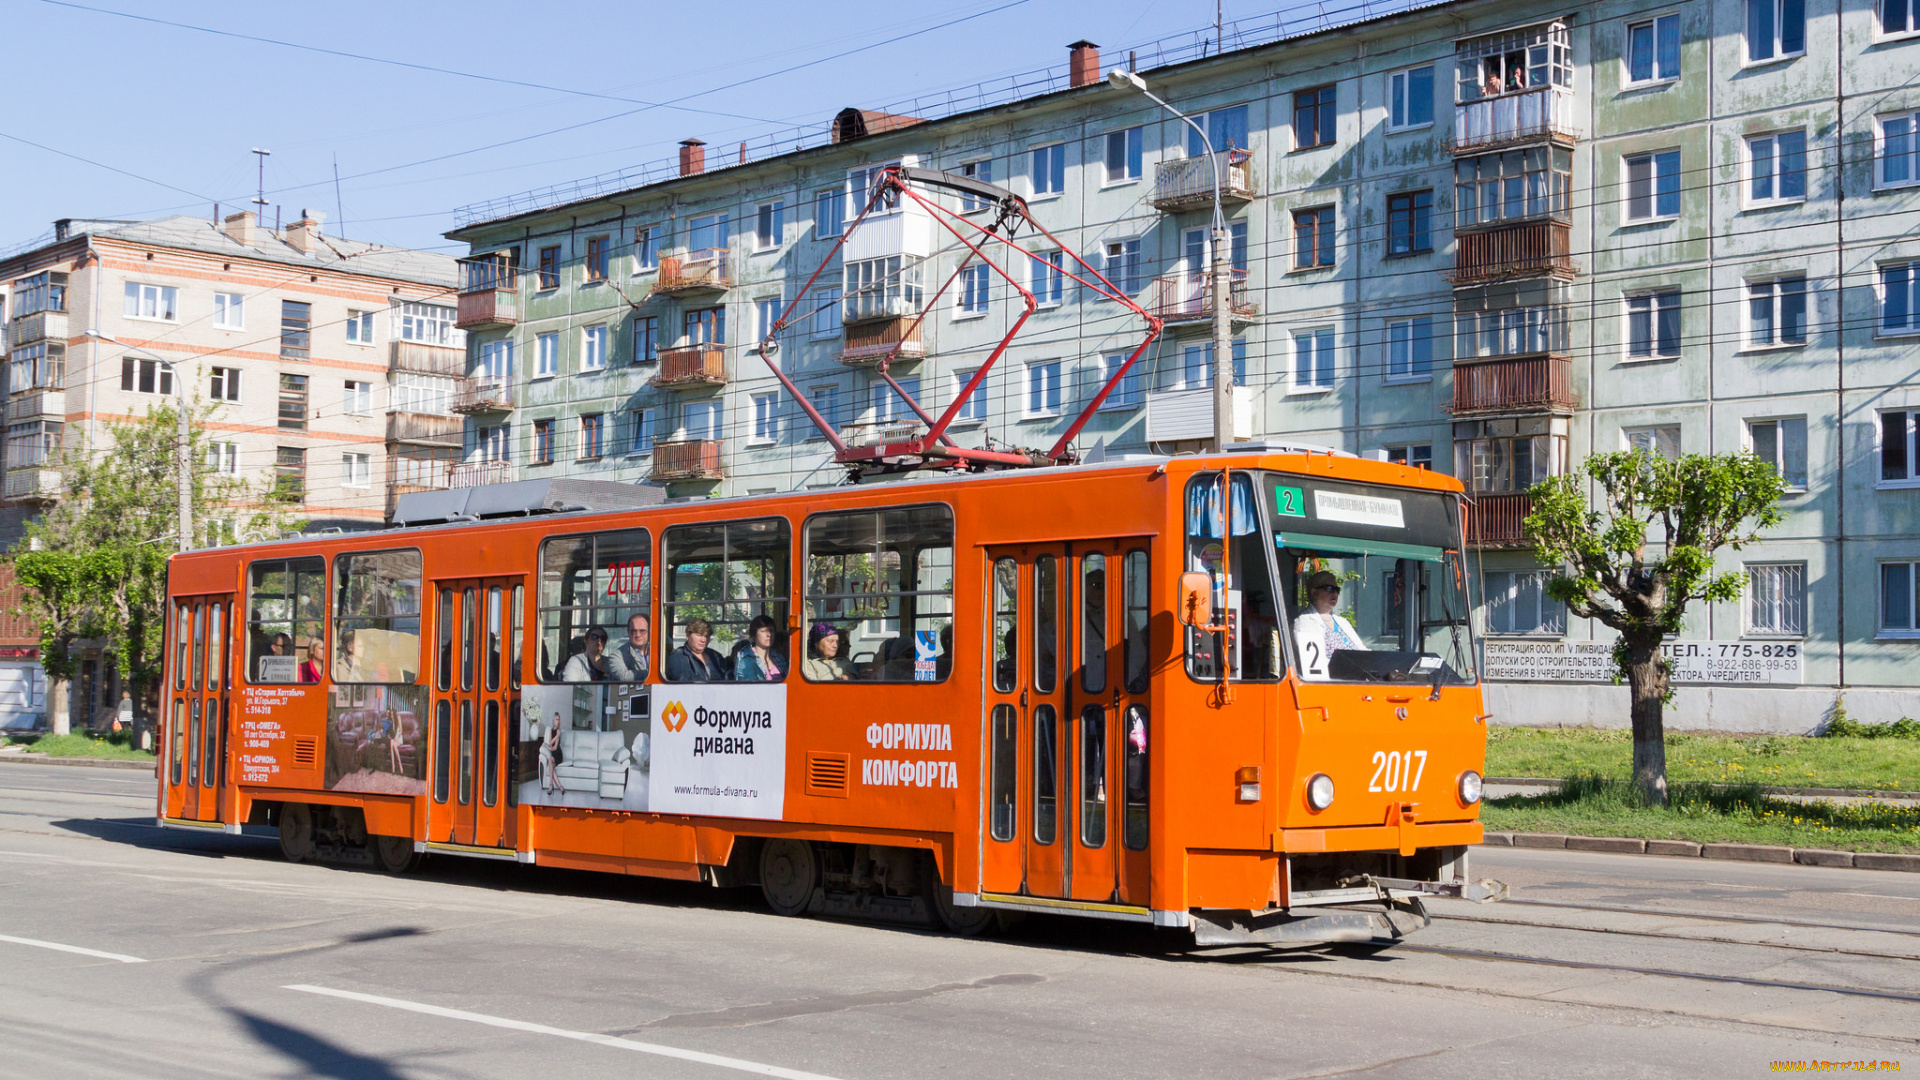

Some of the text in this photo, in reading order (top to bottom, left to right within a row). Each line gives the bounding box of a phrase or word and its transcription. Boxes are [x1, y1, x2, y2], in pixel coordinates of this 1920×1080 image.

[1283, 490, 1296, 513] 2
[607, 560, 645, 595] 2017
[1485, 643, 1534, 655] РЕГИСТРАЦИЯ
[1555, 644, 1565, 654] ИП
[1575, 644, 1615, 656] ЛИКВИДАЦ
[1718, 644, 1797, 658] 775-825
[1306, 641, 1322, 675] 2
[1485, 656, 1519, 667] ДОПУСКИ
[1520, 656, 1535, 667] СРО
[1706, 659, 1798, 671] 8-922-686-99-53
[261, 658, 268, 680] 2
[915, 671, 936, 681] 70 ЛЕТ
[1485, 668, 1529, 678] ИЗМЕНЕНИЯ
[1530, 669, 1535, 678] В
[1537, 669, 1602, 680] УЧРЕДИТЕЛЬНЫЕ
[246, 688, 254, 697] ТЦ
[251, 706, 271, 715] 514-318
[244, 721, 281, 731] ТРЦ «ОМЕГА»
[693, 705, 772, 734] Формула
[279, 731, 286, 739] 32
[866, 722, 952, 751] ФОРМУЛА
[693, 736, 755, 757] дивана
[243, 755, 276, 764] ТЦ «ОРИОН»
[862, 759, 958, 789] КОМФОРТА
[1368, 750, 1428, 793] 2017
[674, 784, 758, 798] www.formula-divana.ru
